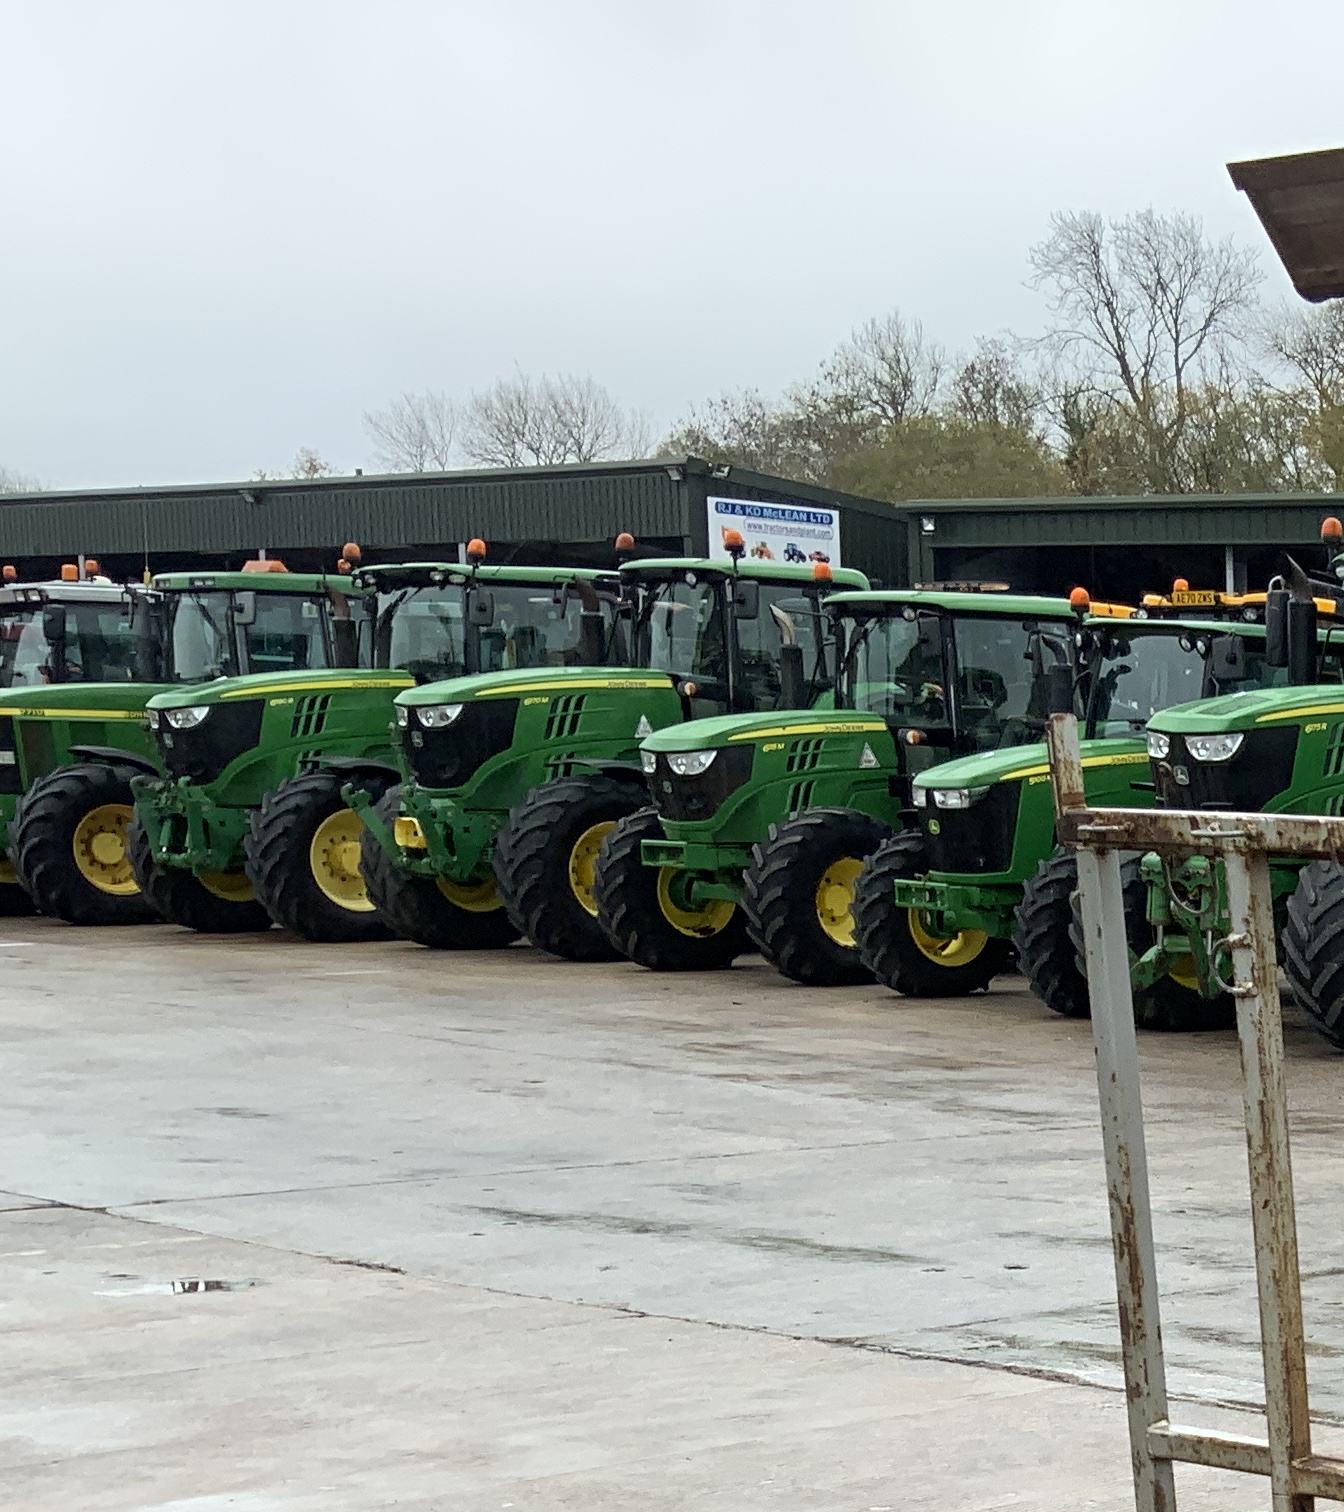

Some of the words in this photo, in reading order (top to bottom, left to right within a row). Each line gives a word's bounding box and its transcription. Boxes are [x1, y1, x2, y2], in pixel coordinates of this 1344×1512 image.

[717, 502, 732, 513] RJ
[734, 505, 743, 514] &
[763, 508, 807, 521] McLEAN
[809, 512, 831, 524] LTD
